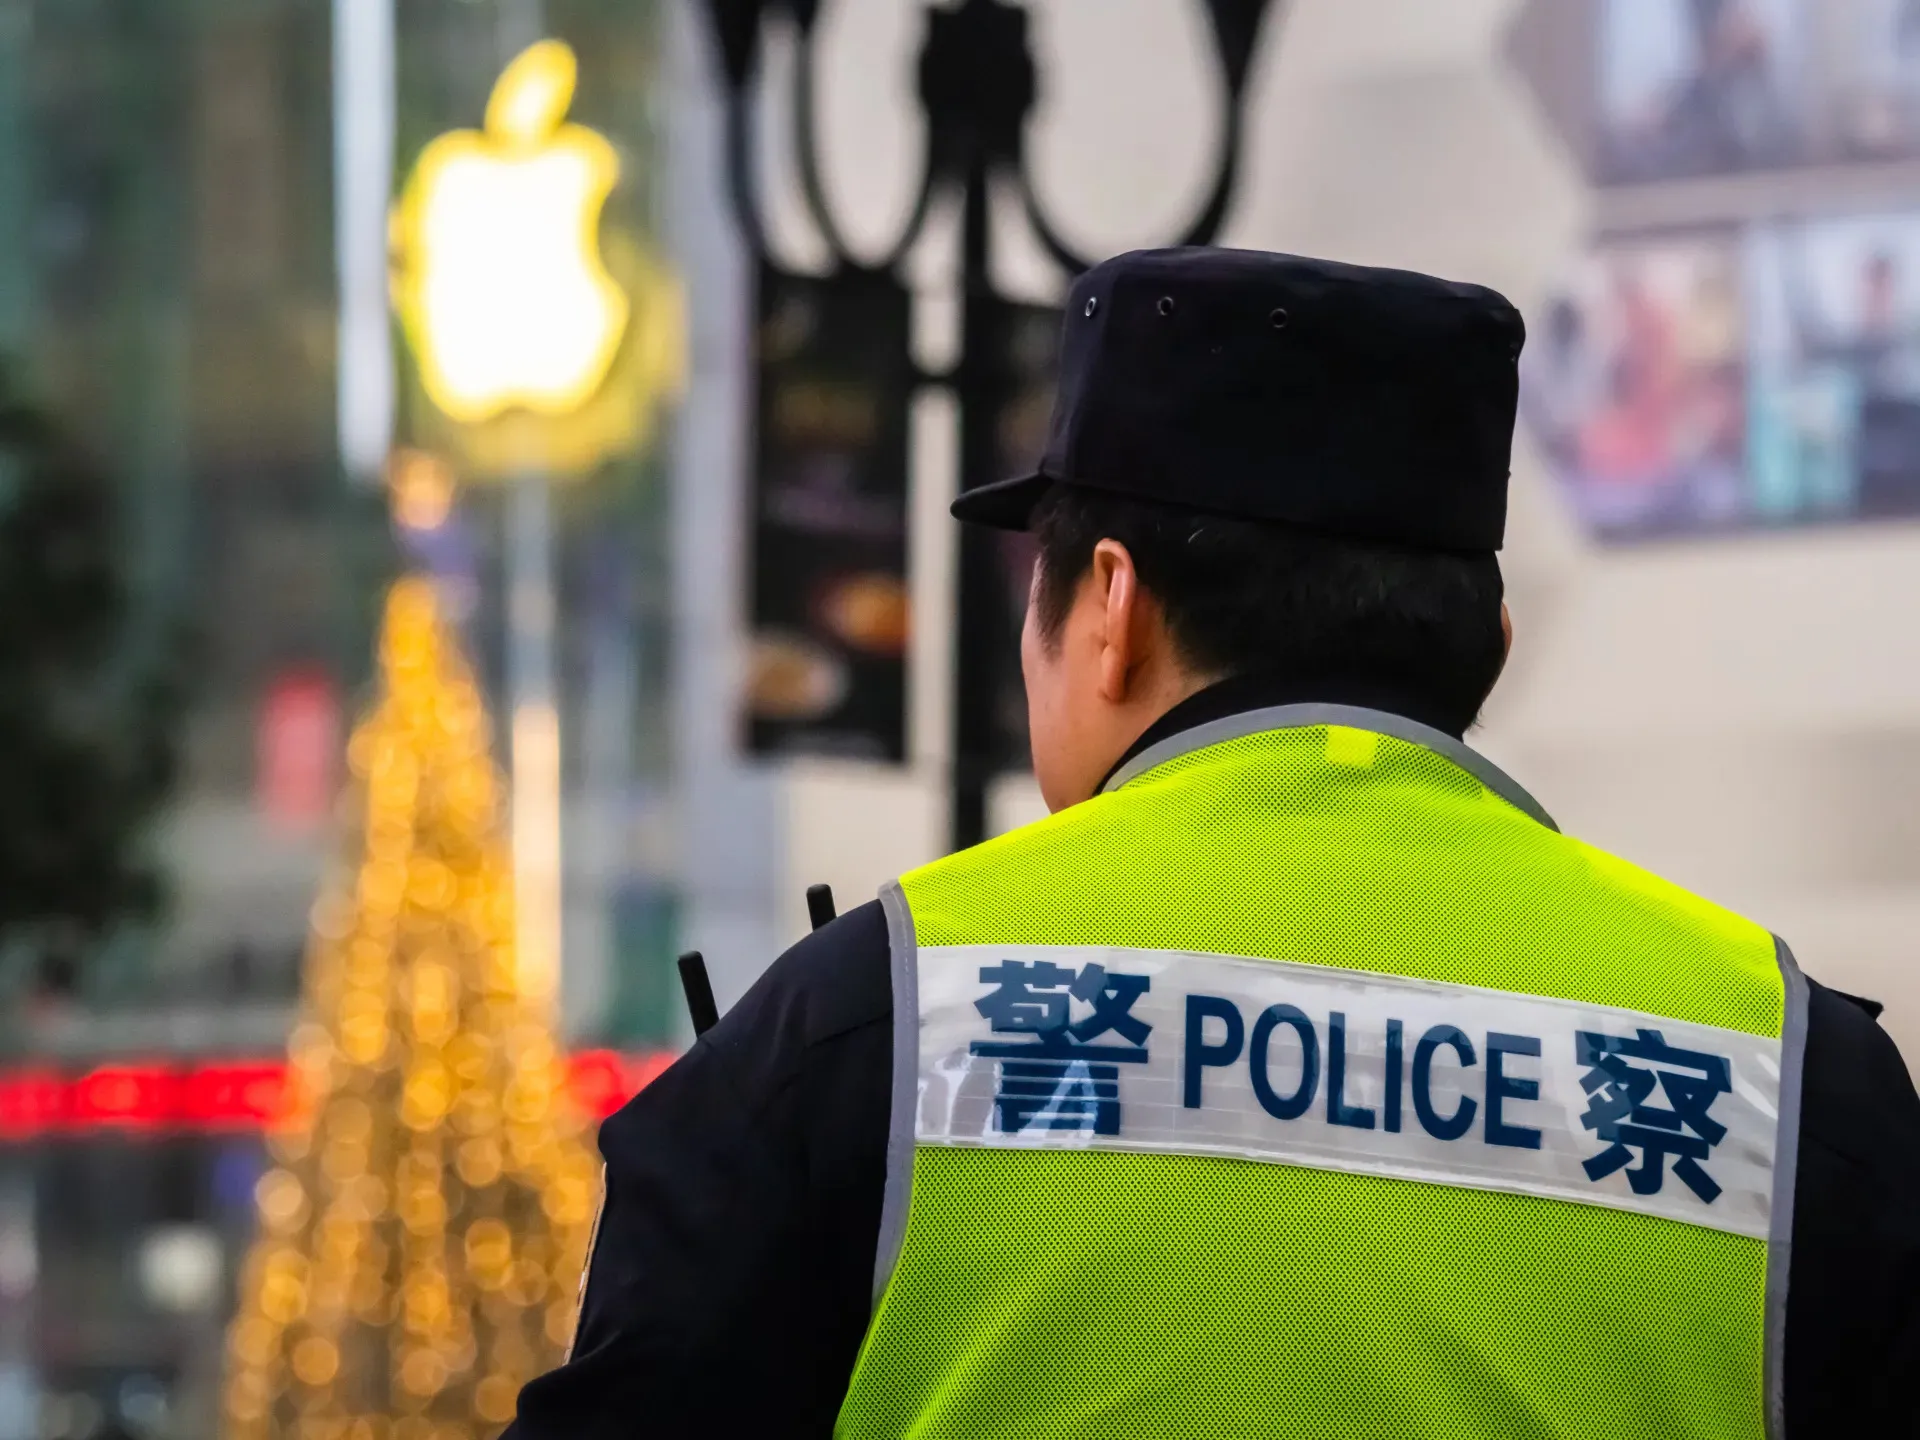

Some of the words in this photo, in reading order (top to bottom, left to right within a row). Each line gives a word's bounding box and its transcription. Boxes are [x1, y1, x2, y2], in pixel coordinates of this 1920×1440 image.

[969, 960, 1153, 1136] 警
[1183, 995, 1543, 1150] POLICE
[1576, 1029, 1733, 1204] 察
